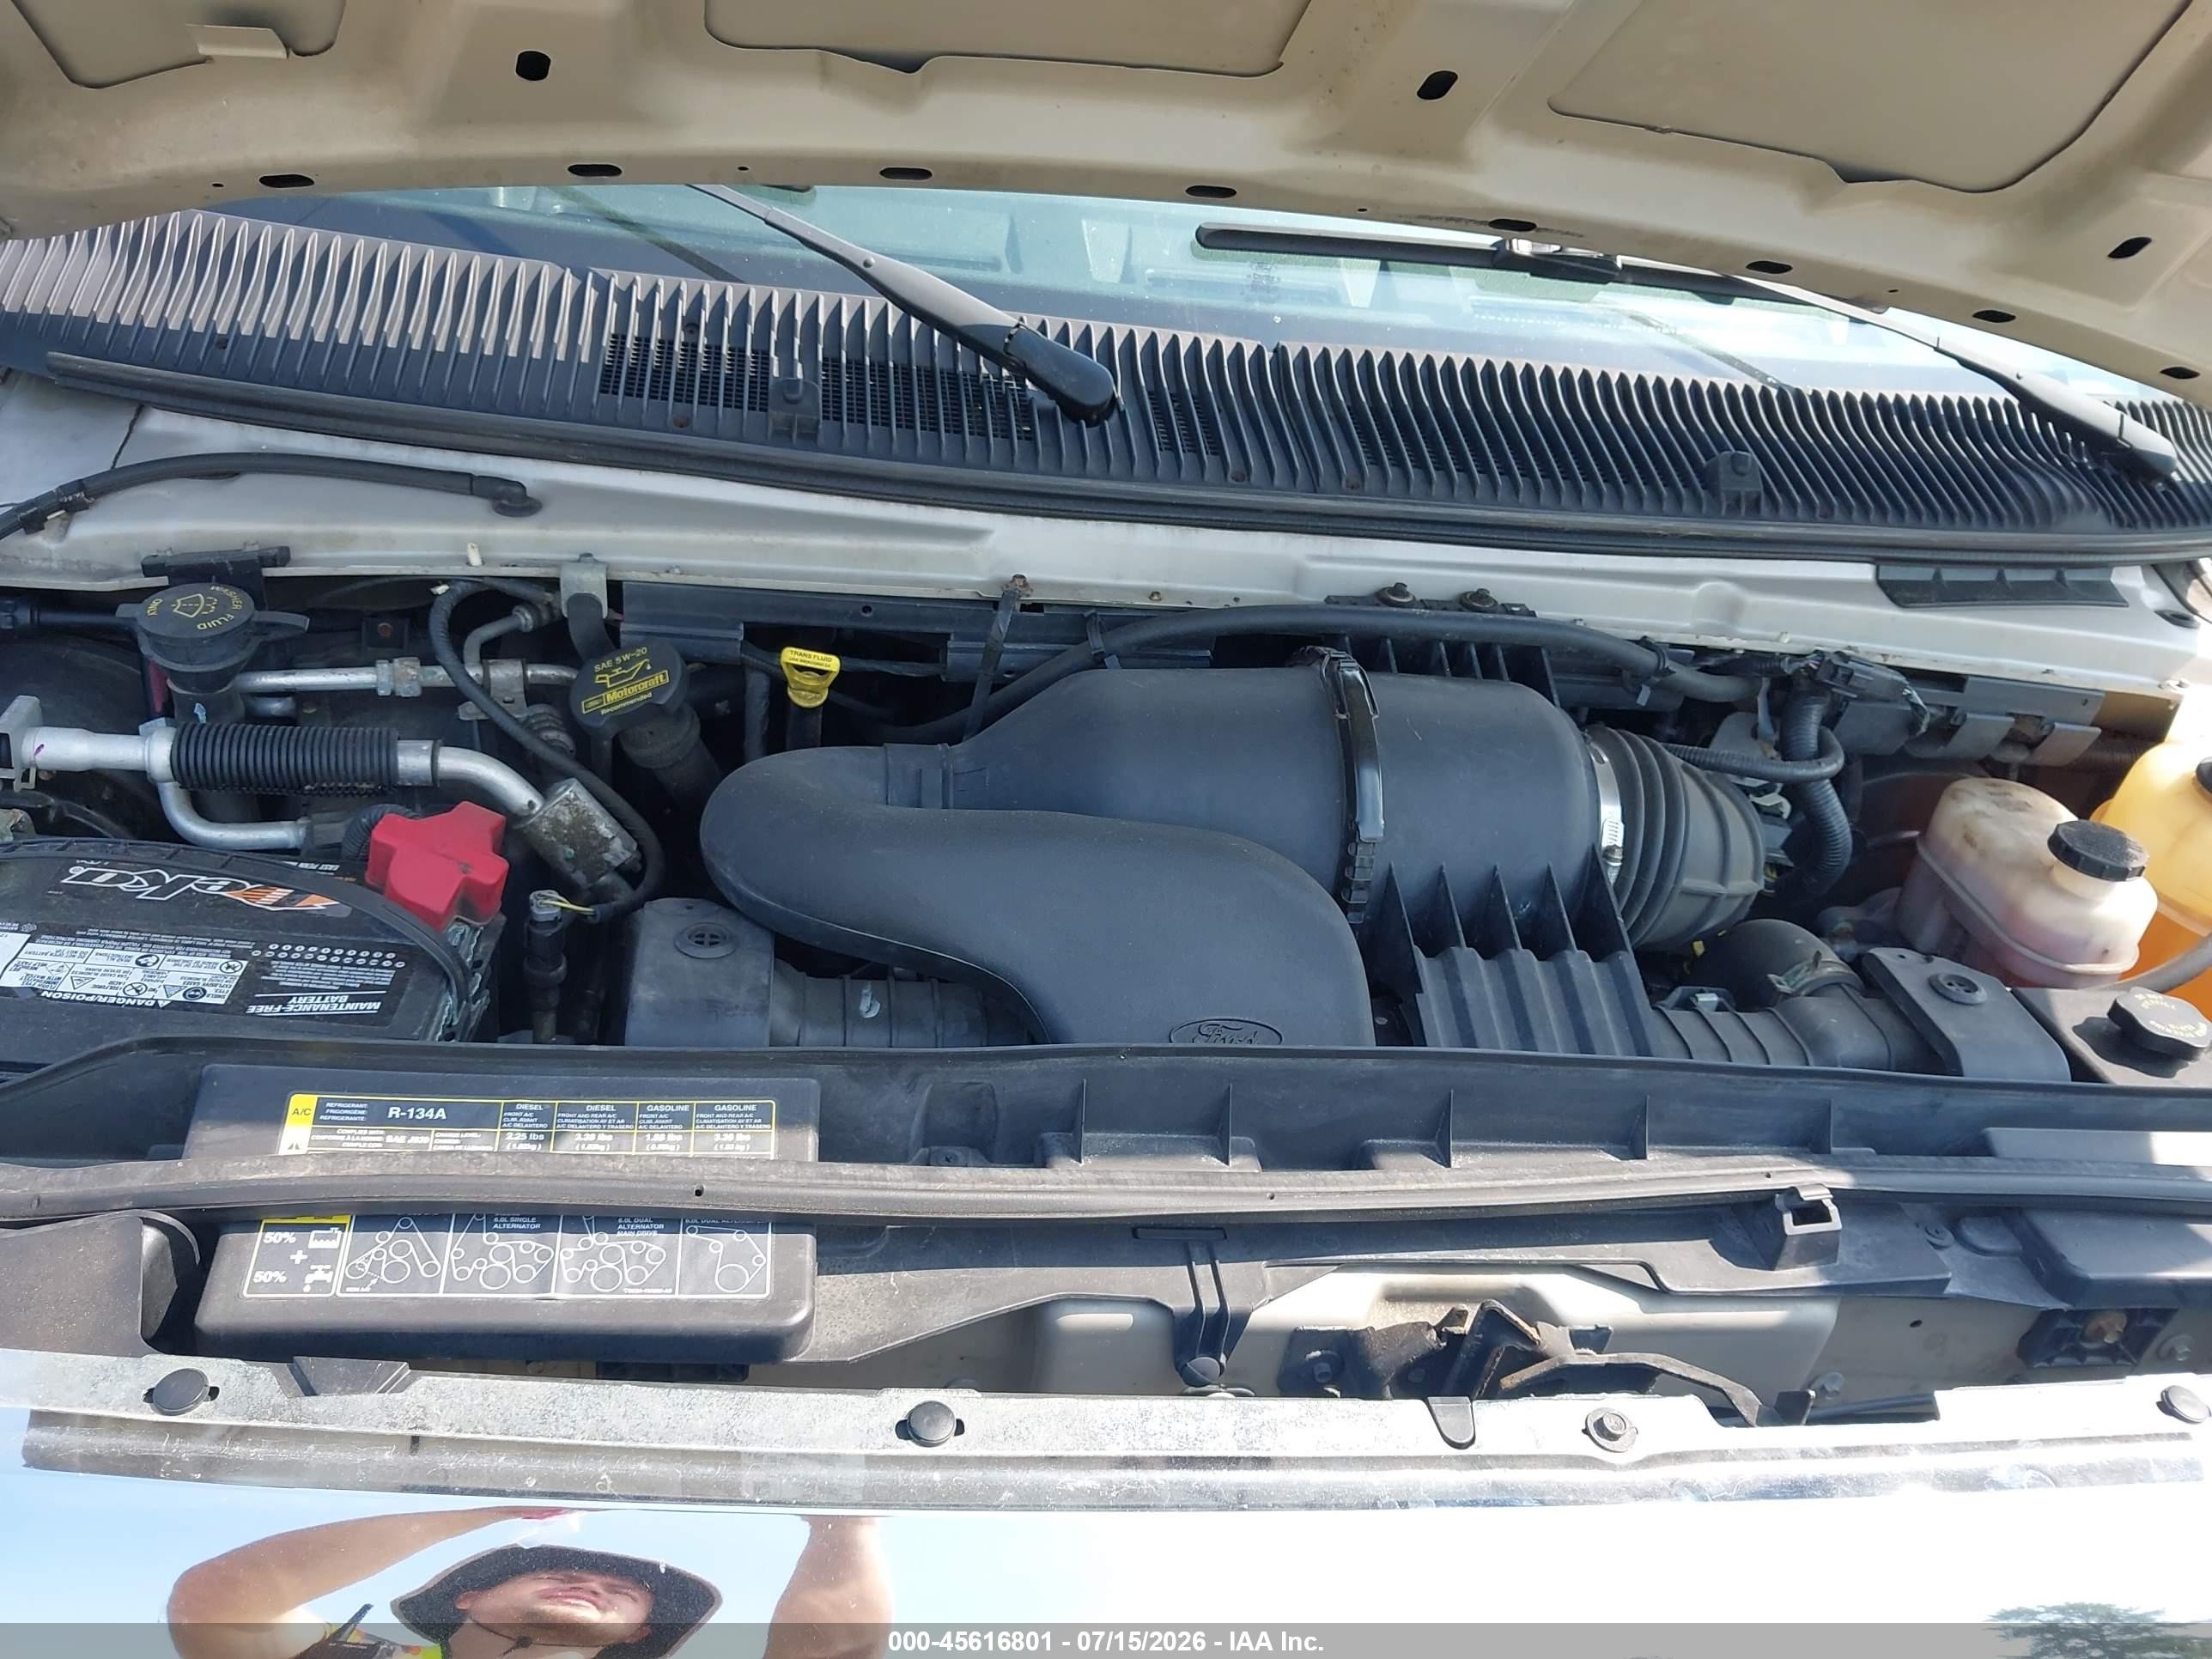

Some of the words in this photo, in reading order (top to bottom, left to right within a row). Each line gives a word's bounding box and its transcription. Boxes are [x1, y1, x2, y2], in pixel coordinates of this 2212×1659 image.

[210, 586, 242, 611] WASHER
[147, 598, 163, 617] ONLY
[197, 613, 234, 630] FLUID
[790, 650, 811, 659] TRANS
[594, 659, 612, 672] SAE
[606, 672, 665, 702] Motorcraft
[601, 692, 653, 714] Recommended
[40, 990, 156, 1006] DANGER/POISON
[287, 994, 349, 1004] BATTERY
[246, 1001, 382, 1013] MAINTENANCE-FREE
[292, 1107, 311, 1116] A/C
[387, 1106, 447, 1121] R-134A
[505, 1132, 527, 1140] 2.25
[264, 1232, 296, 1244] 50%
[253, 1271, 287, 1283] 50%
